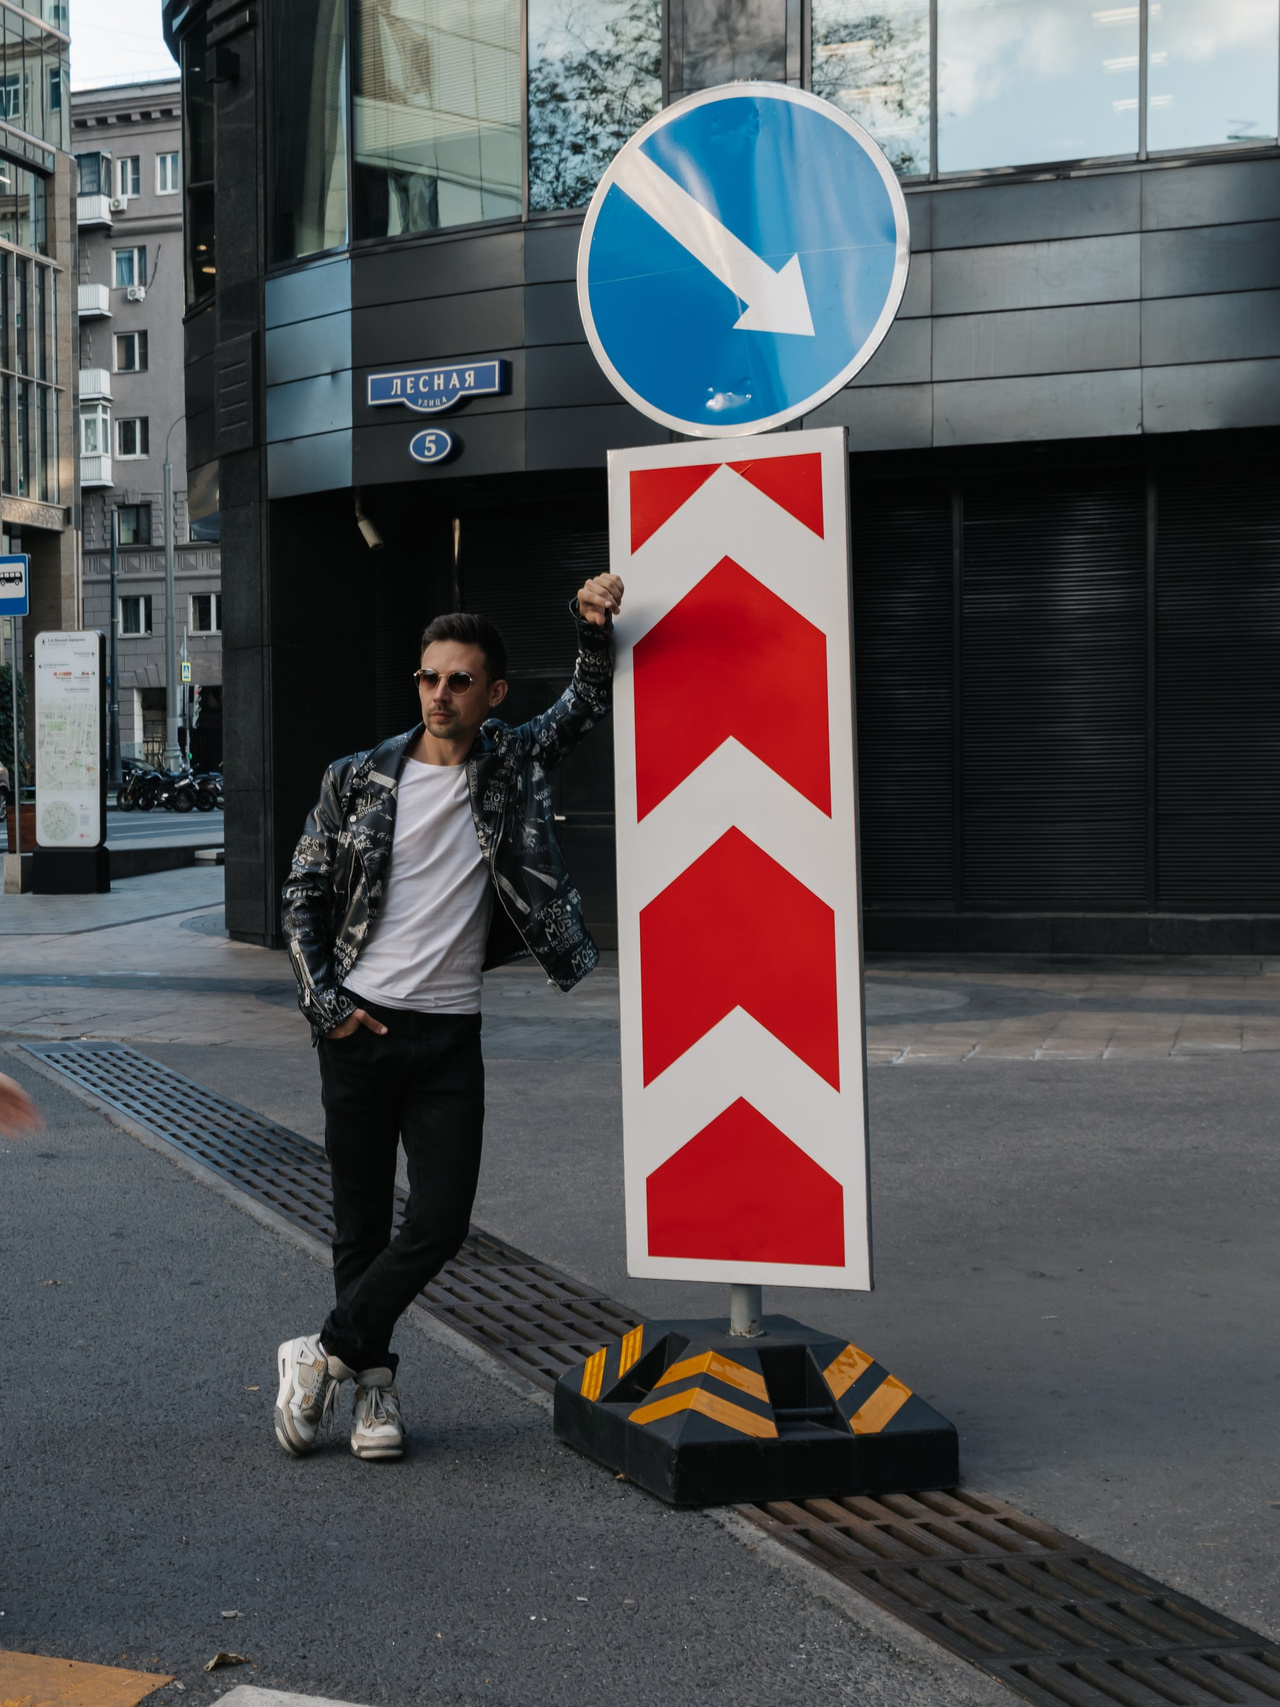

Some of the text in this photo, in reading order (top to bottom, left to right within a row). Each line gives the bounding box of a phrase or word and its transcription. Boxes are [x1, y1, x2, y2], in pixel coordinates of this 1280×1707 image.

[390, 370, 476, 396] ЛЕСНАЯ
[417, 396, 448, 408] УЛИЦА
[424, 435, 437, 456] 5
